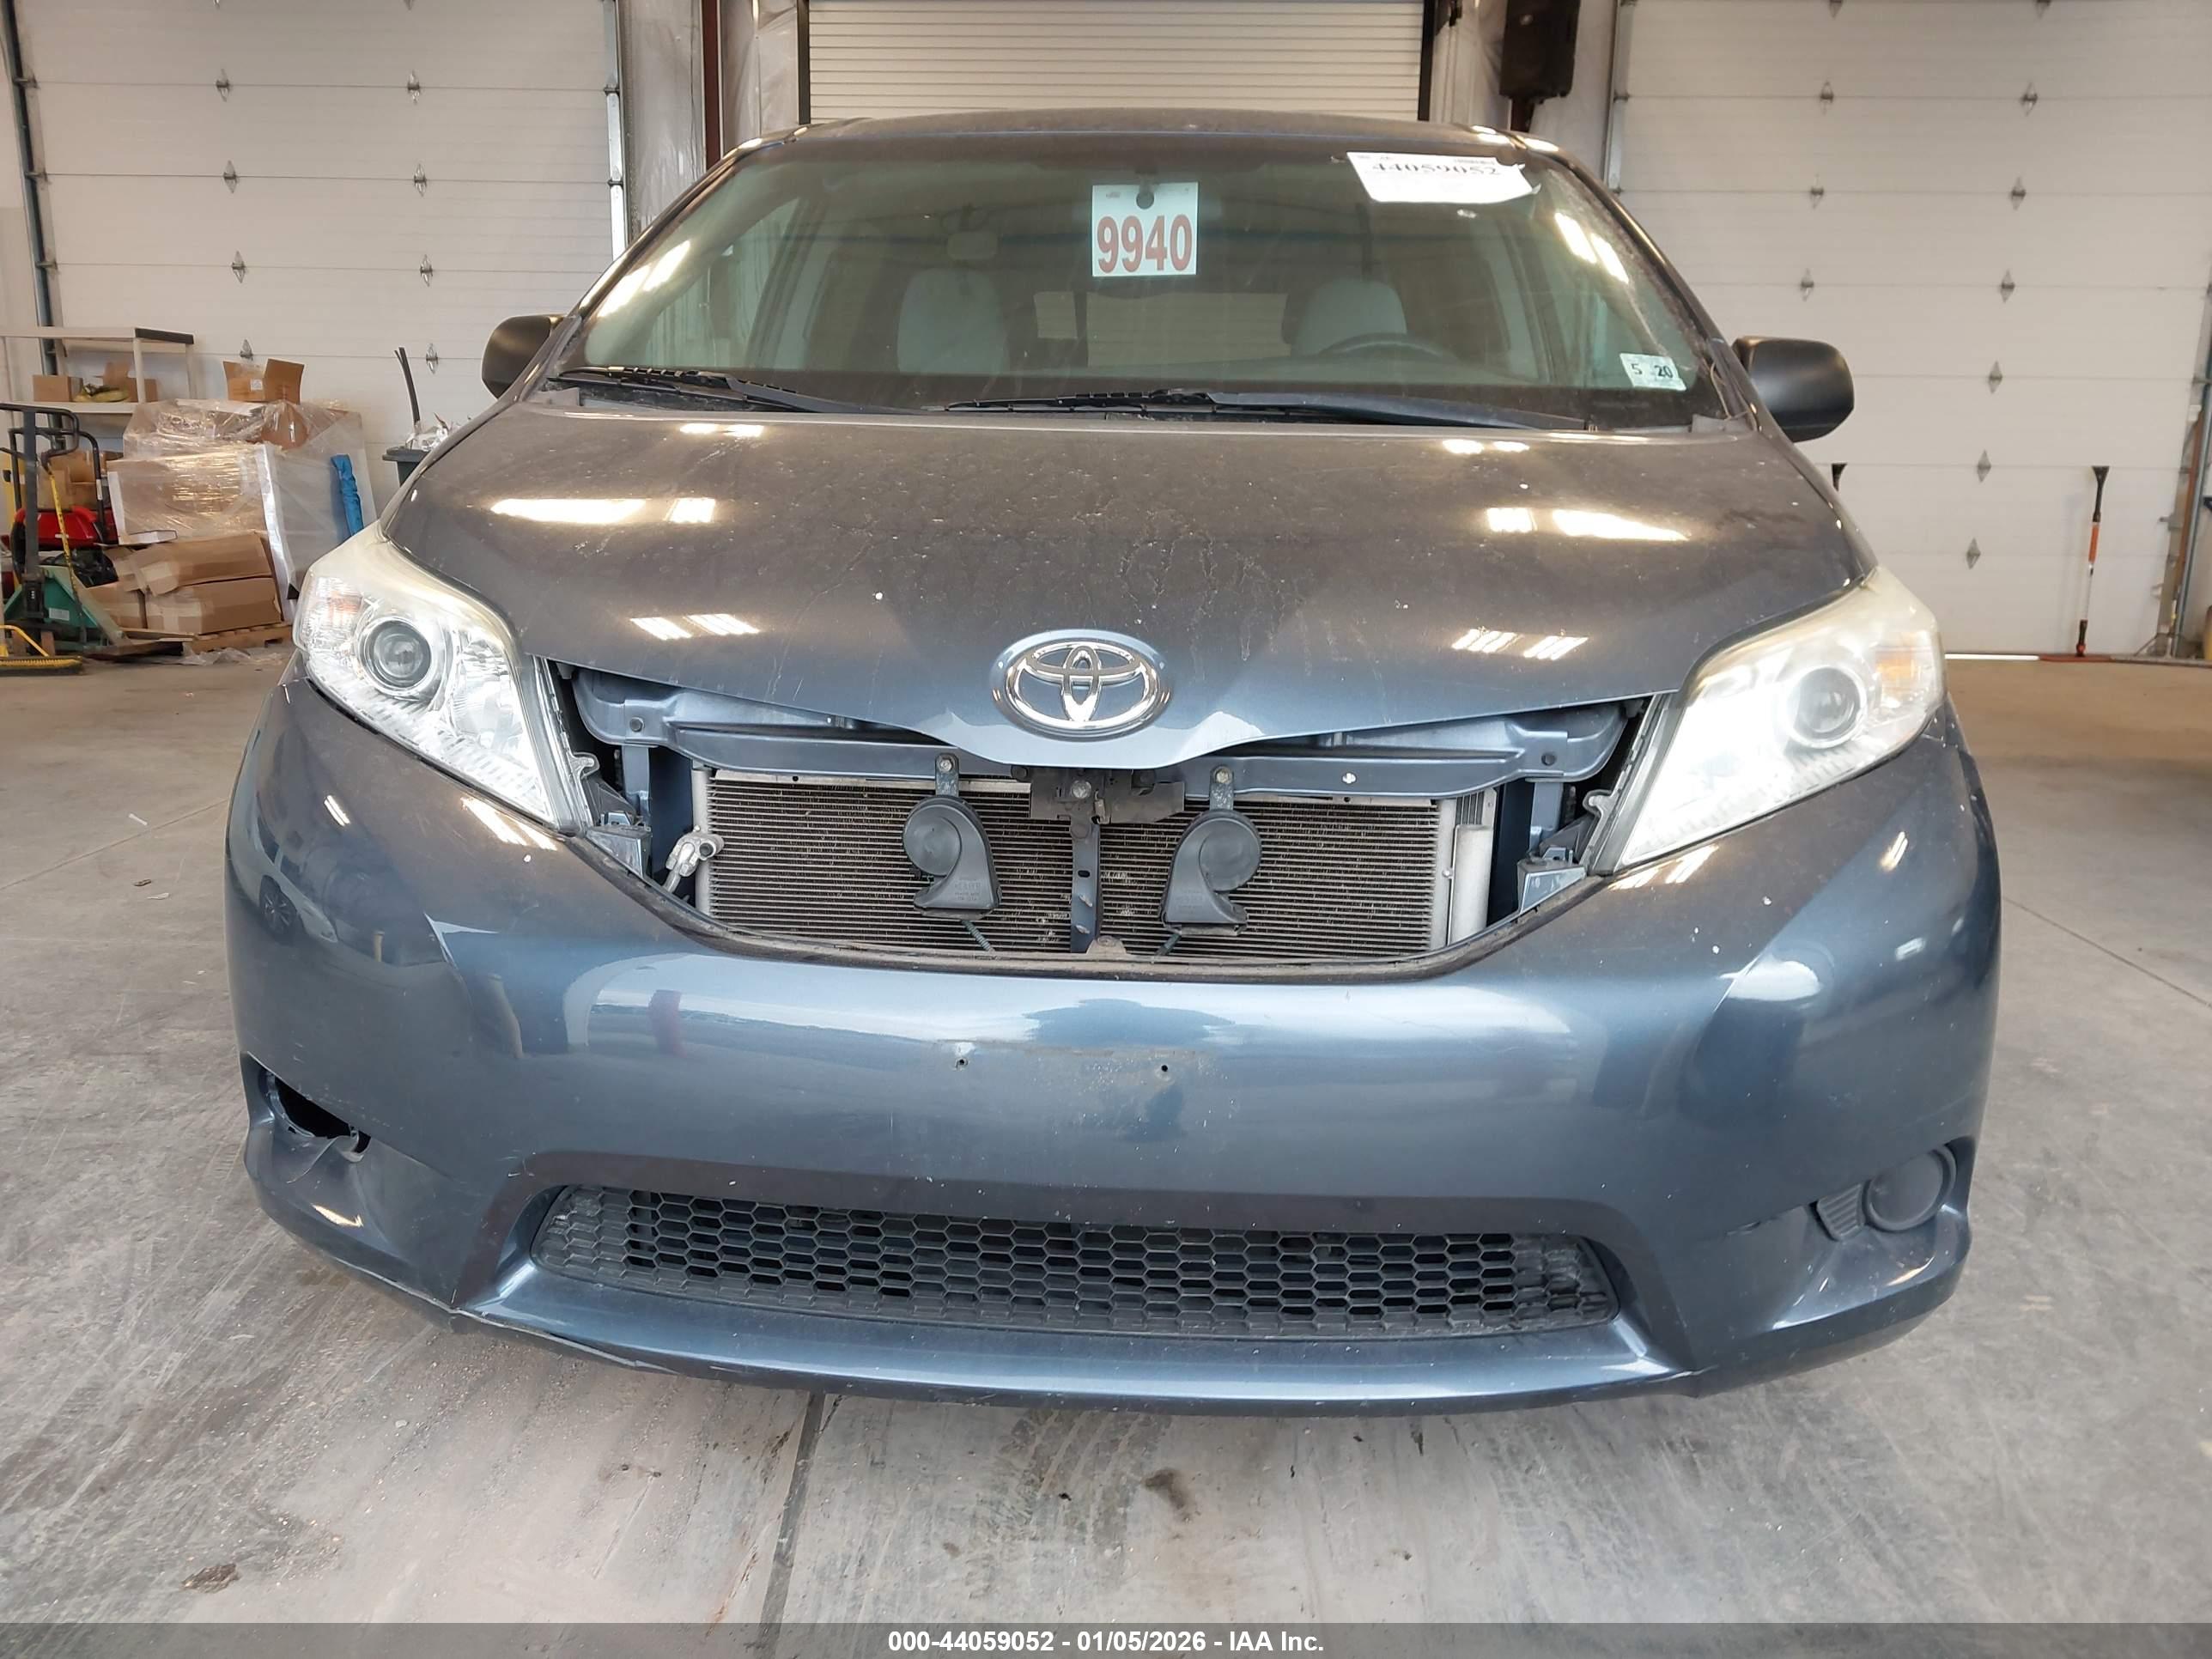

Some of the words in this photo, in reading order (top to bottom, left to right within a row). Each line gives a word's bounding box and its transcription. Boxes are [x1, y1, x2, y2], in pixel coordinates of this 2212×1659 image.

[1097, 214, 1193, 273] 9940
[1631, 363, 1642, 375] 5
[1654, 365, 1674, 379] 20
